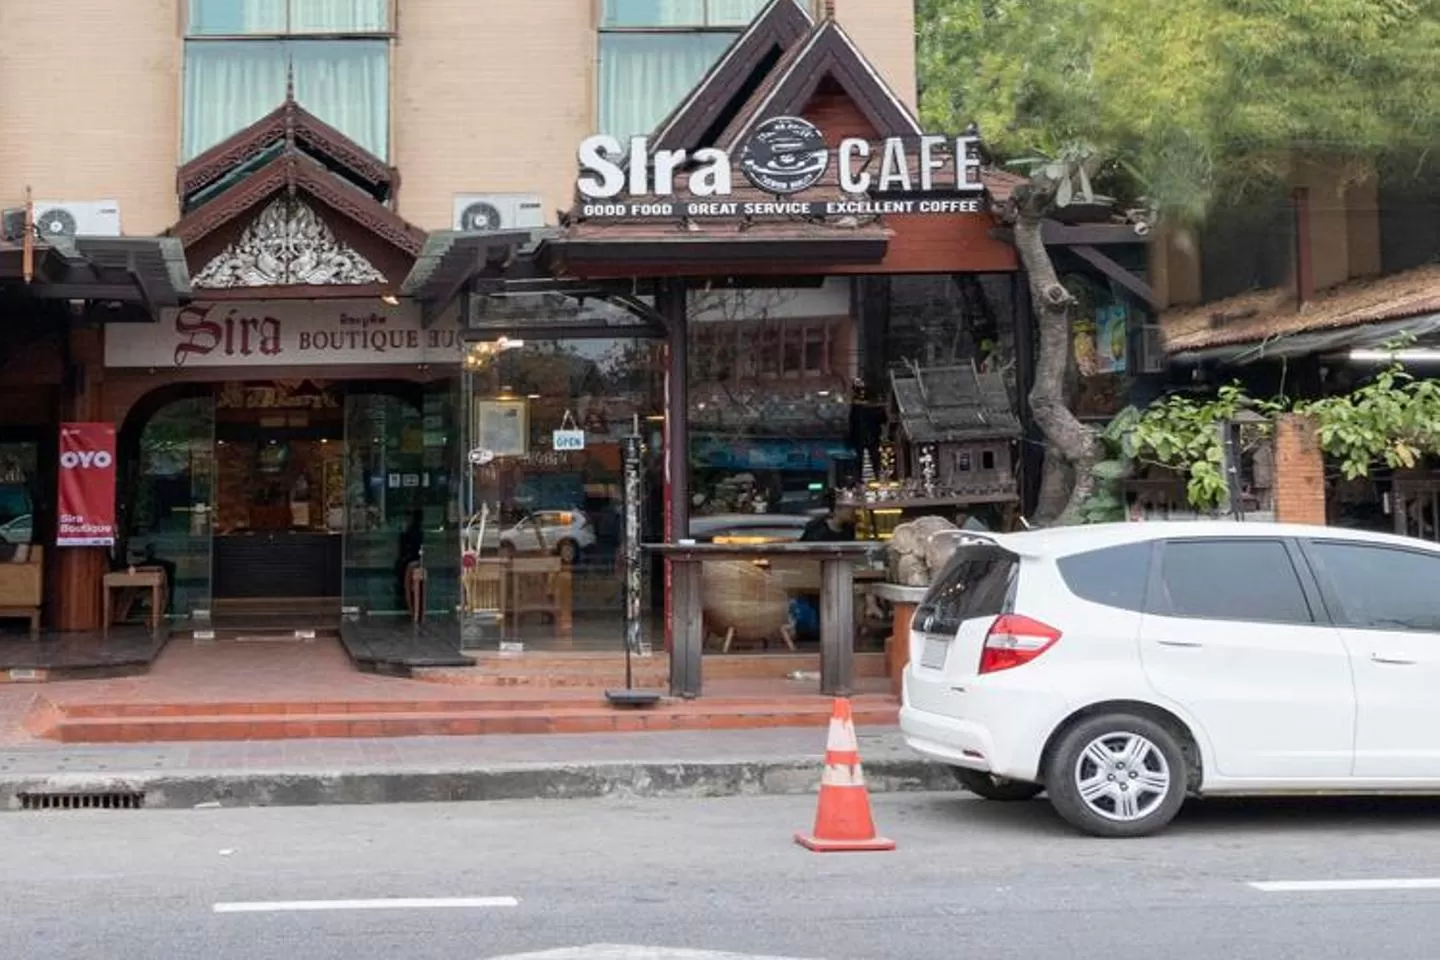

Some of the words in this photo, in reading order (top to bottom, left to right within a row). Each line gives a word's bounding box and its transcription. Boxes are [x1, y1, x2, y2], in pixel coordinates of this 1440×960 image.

[584, 204, 626, 216] GOOD
[631, 204, 672, 216] FOOD
[688, 203, 737, 215] GREAT
[744, 202, 810, 214] SERVICE
[827, 201, 913, 214] EXCELLENT
[919, 201, 978, 213] COFFEE
[173, 303, 283, 366] Sira
[299, 329, 420, 352] BOUTIQUE
[556, 437, 581, 448] OPEN
[61, 451, 112, 468] OYO
